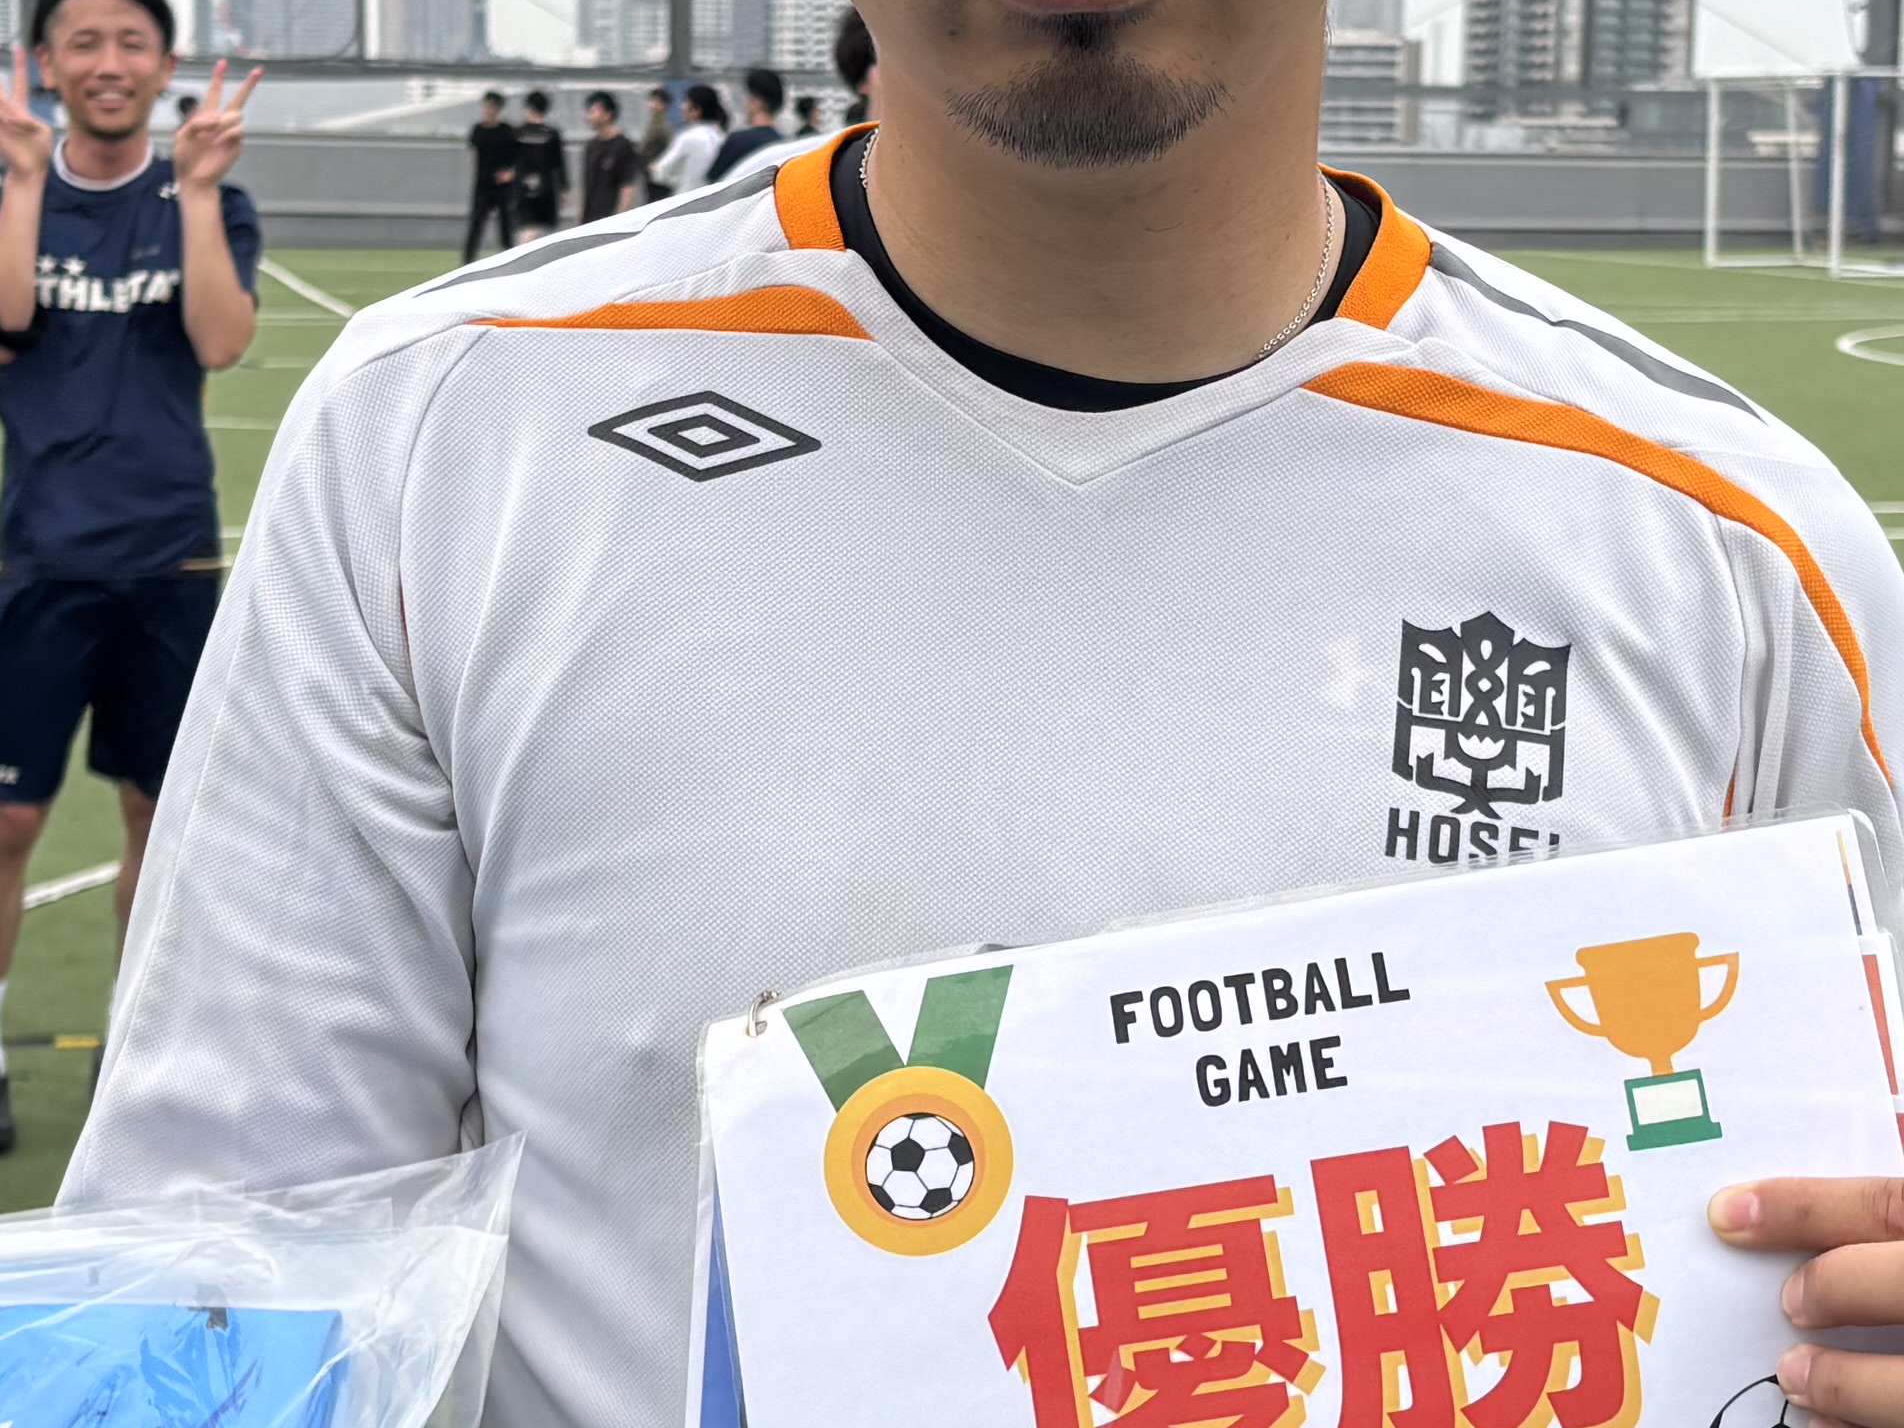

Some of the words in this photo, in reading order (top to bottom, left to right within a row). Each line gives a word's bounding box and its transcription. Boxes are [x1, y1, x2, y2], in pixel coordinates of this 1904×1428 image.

[36, 270, 181, 313] THLETA
[1110, 951, 1411, 1044] FOOTBALL
[1195, 1035, 1348, 1107] GAME
